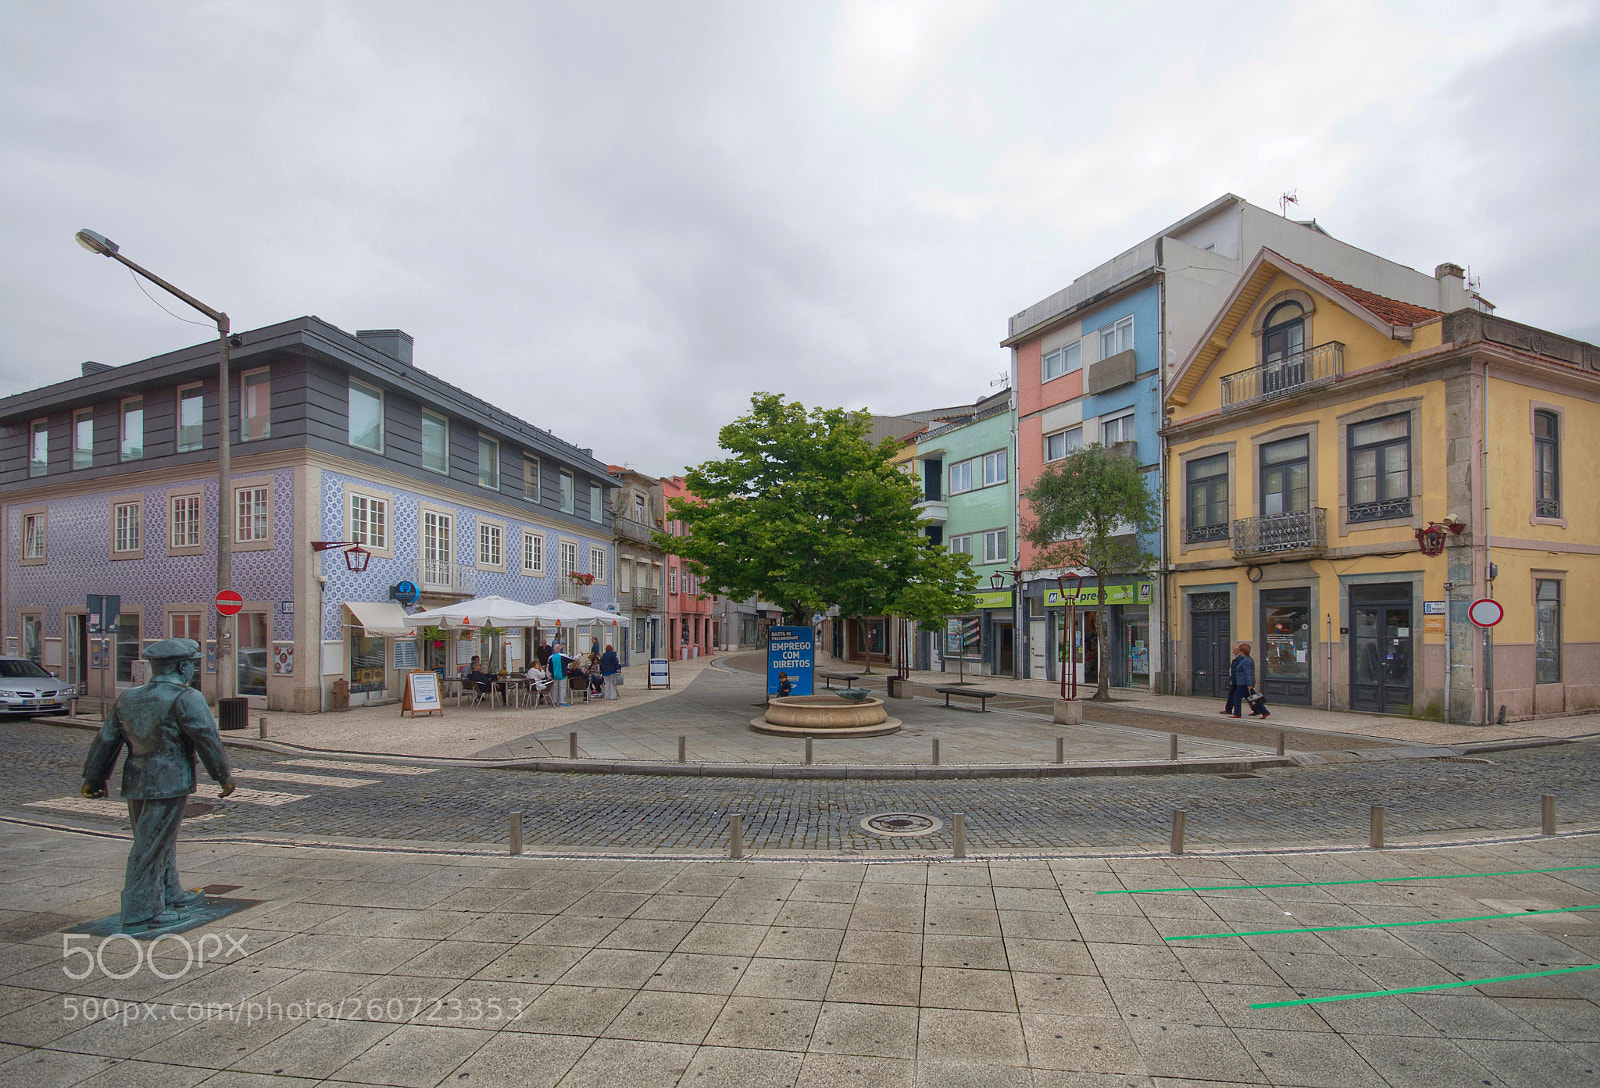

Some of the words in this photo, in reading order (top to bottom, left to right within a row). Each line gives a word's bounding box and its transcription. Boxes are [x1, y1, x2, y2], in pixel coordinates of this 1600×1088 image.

[771, 641, 811, 651] EMPREGO
[782, 651, 800, 660] COM
[773, 659, 810, 669] DIREITOS
